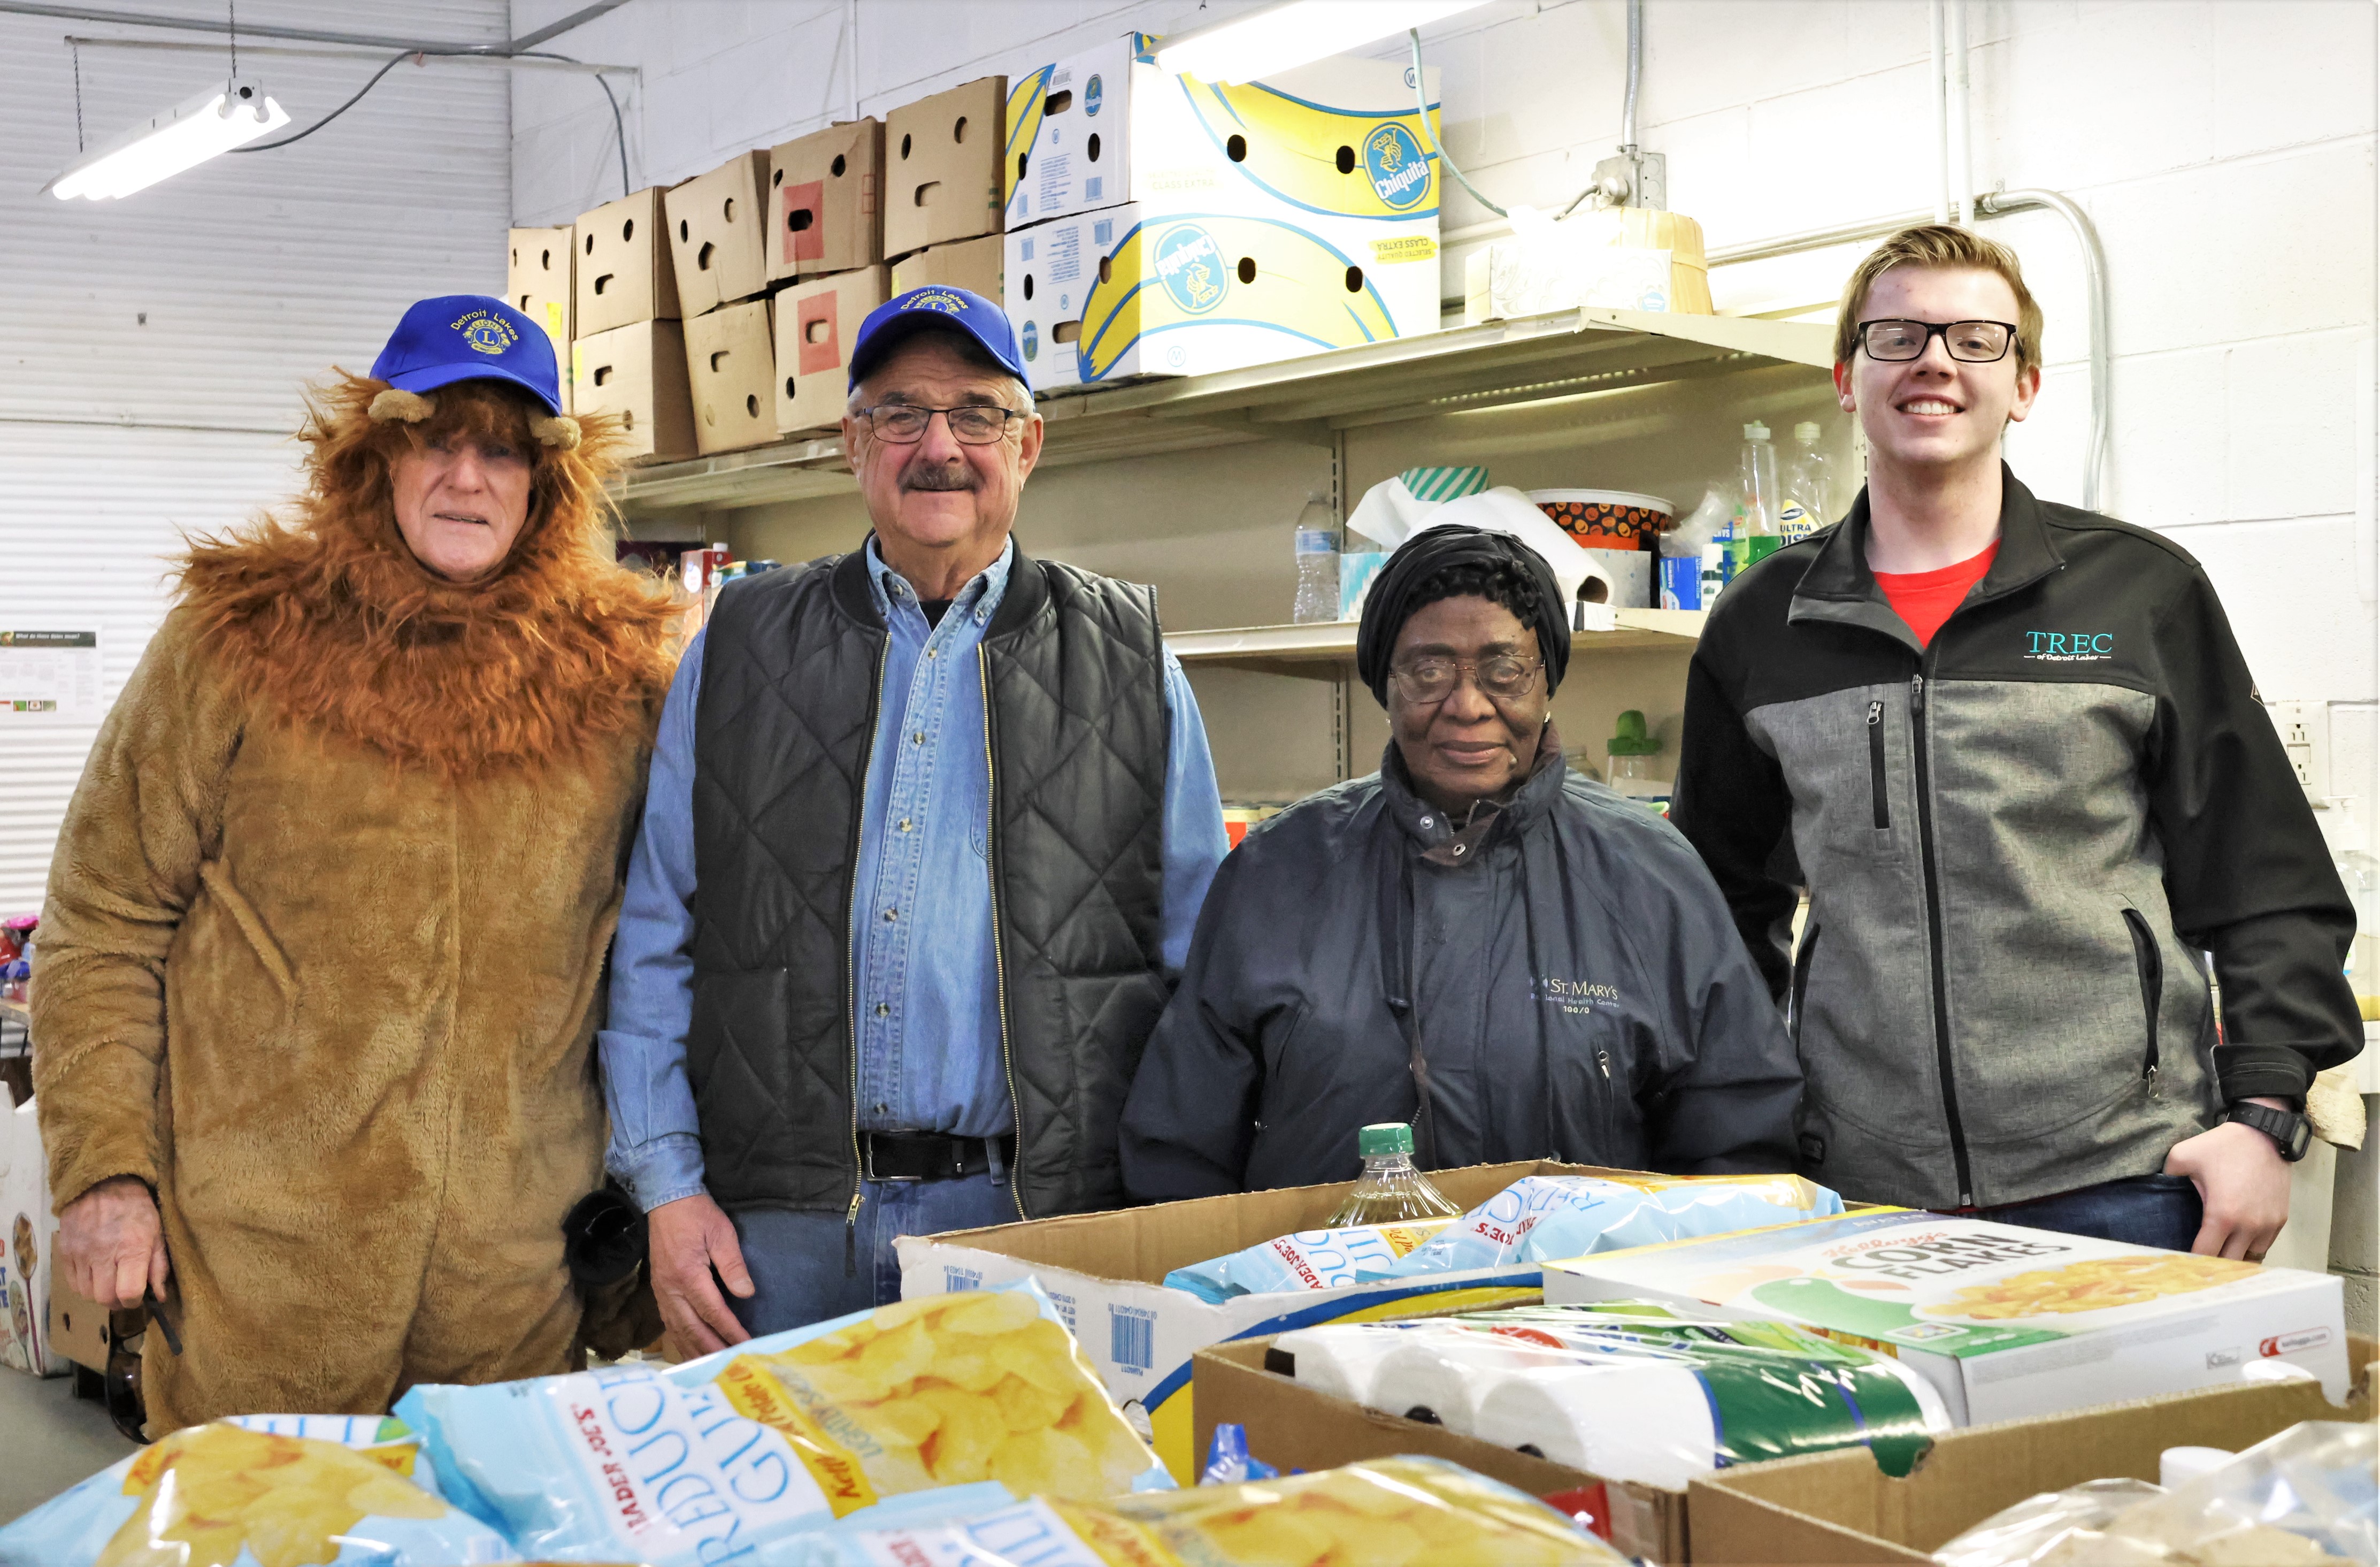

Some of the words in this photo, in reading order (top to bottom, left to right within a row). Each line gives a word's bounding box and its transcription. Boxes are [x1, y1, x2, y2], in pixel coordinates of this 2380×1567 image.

[1153, 180, 1181, 189] CLASS
[1185, 179, 1215, 188] EXTRA
[1375, 160, 1429, 200] Chiquita
[1377, 241, 1403, 250] EXTRA
[1405, 249, 1432, 257] SELECTED
[1406, 239, 1428, 247] CLASS
[1155, 235, 1216, 276] Chiquita
[1377, 251, 1402, 260] QUALITY
[901, 289, 935, 309] Detroit
[942, 291, 968, 309] Lakes
[450, 309, 487, 330] Detroit
[494, 313, 518, 340] Lakes
[474, 320, 501, 331] LIONS
[482, 331, 495, 345] L
[2026, 631, 2112, 654] TREC
[1832, 1234, 2023, 1268] CORN
[1878, 1242, 2072, 1279] FLAKES
[1295, 1260, 1324, 1289] ADER
